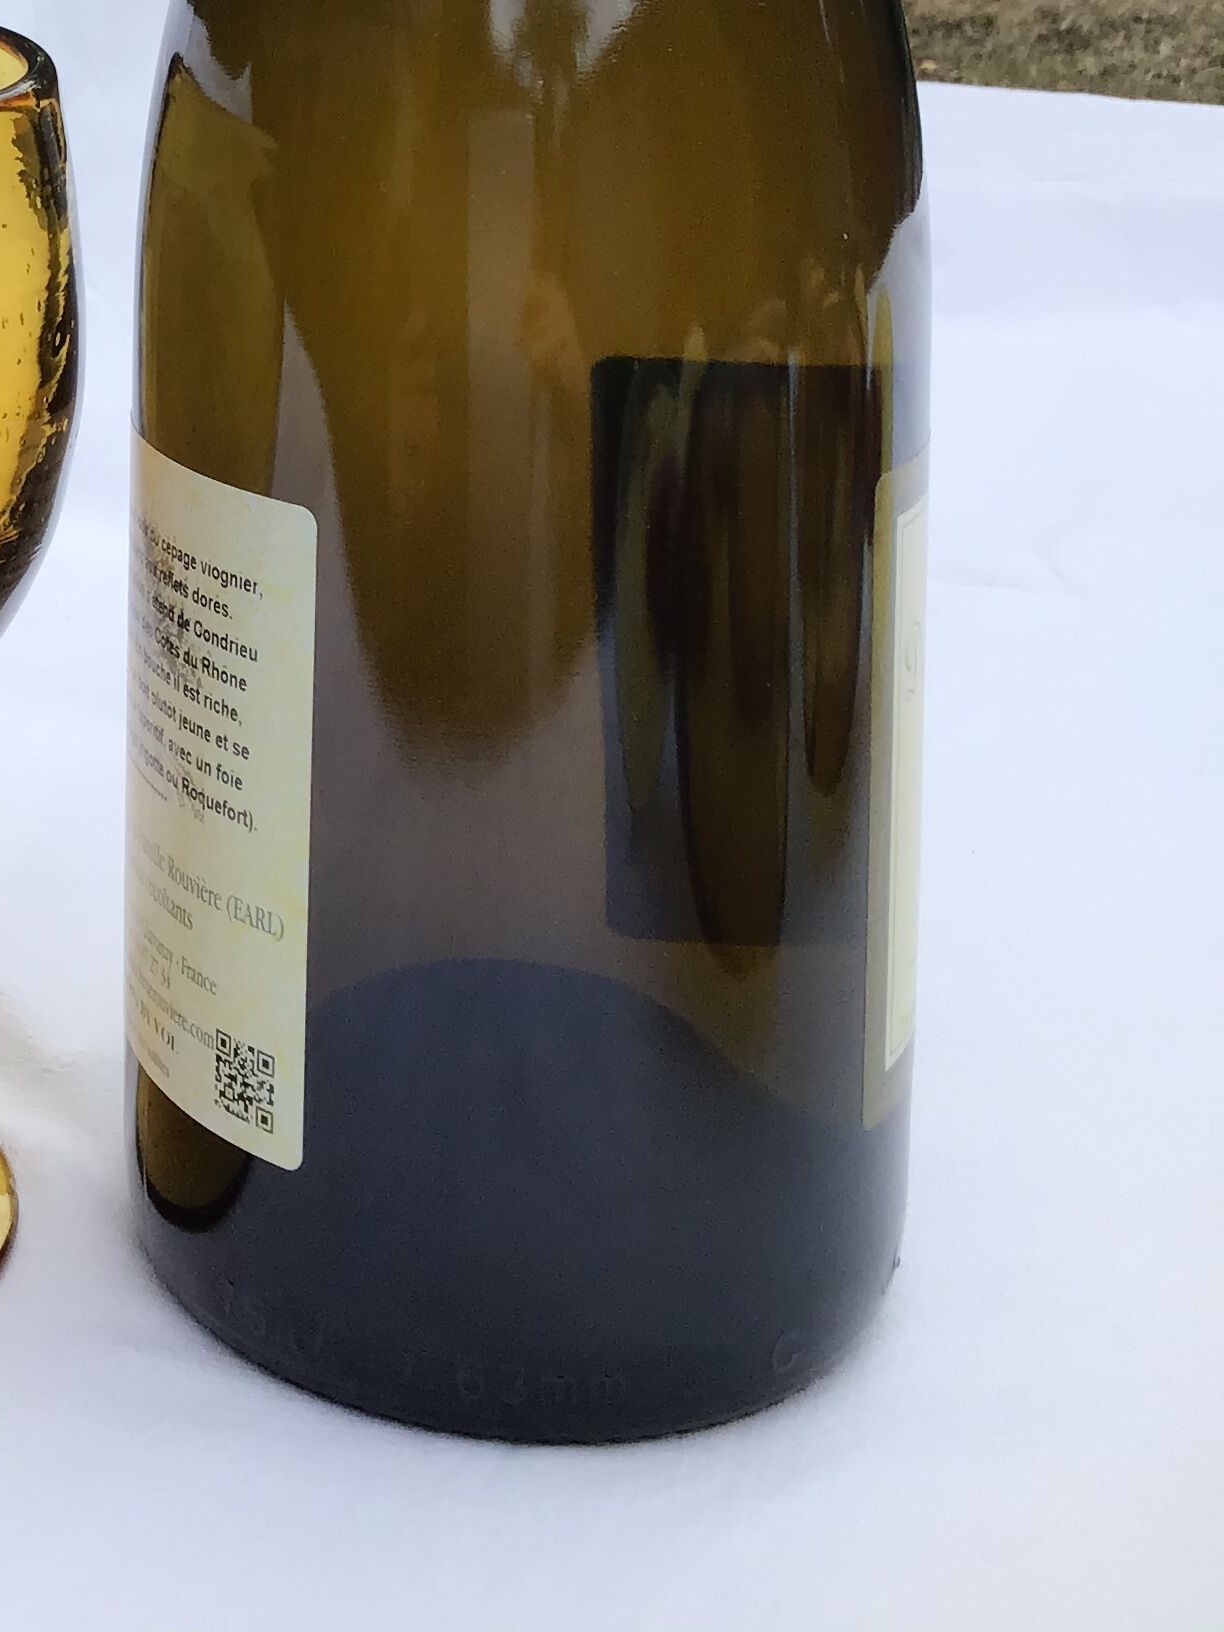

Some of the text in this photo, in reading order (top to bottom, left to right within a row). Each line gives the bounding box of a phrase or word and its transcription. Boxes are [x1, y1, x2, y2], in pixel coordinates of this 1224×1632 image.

[200, 559, 263, 600] viognier,
[183, 647, 198, 670] du
[193, 619, 258, 663] Condrieu
[183, 683, 200, 705] est
[203, 693, 242, 727] riche,
[178, 709, 211, 743] jeune
[216, 733, 228, 752] et
[232, 741, 250, 760] se
[168, 738, 192, 765] avec
[196, 756, 212, 777] un
[216, 763, 243, 790] foie
[182, 776, 258, 833] Roquefort).
[167, 855, 223, 911] Rouvière
[226, 894, 285, 942] (EARL)
[181, 955, 217, 996] France
